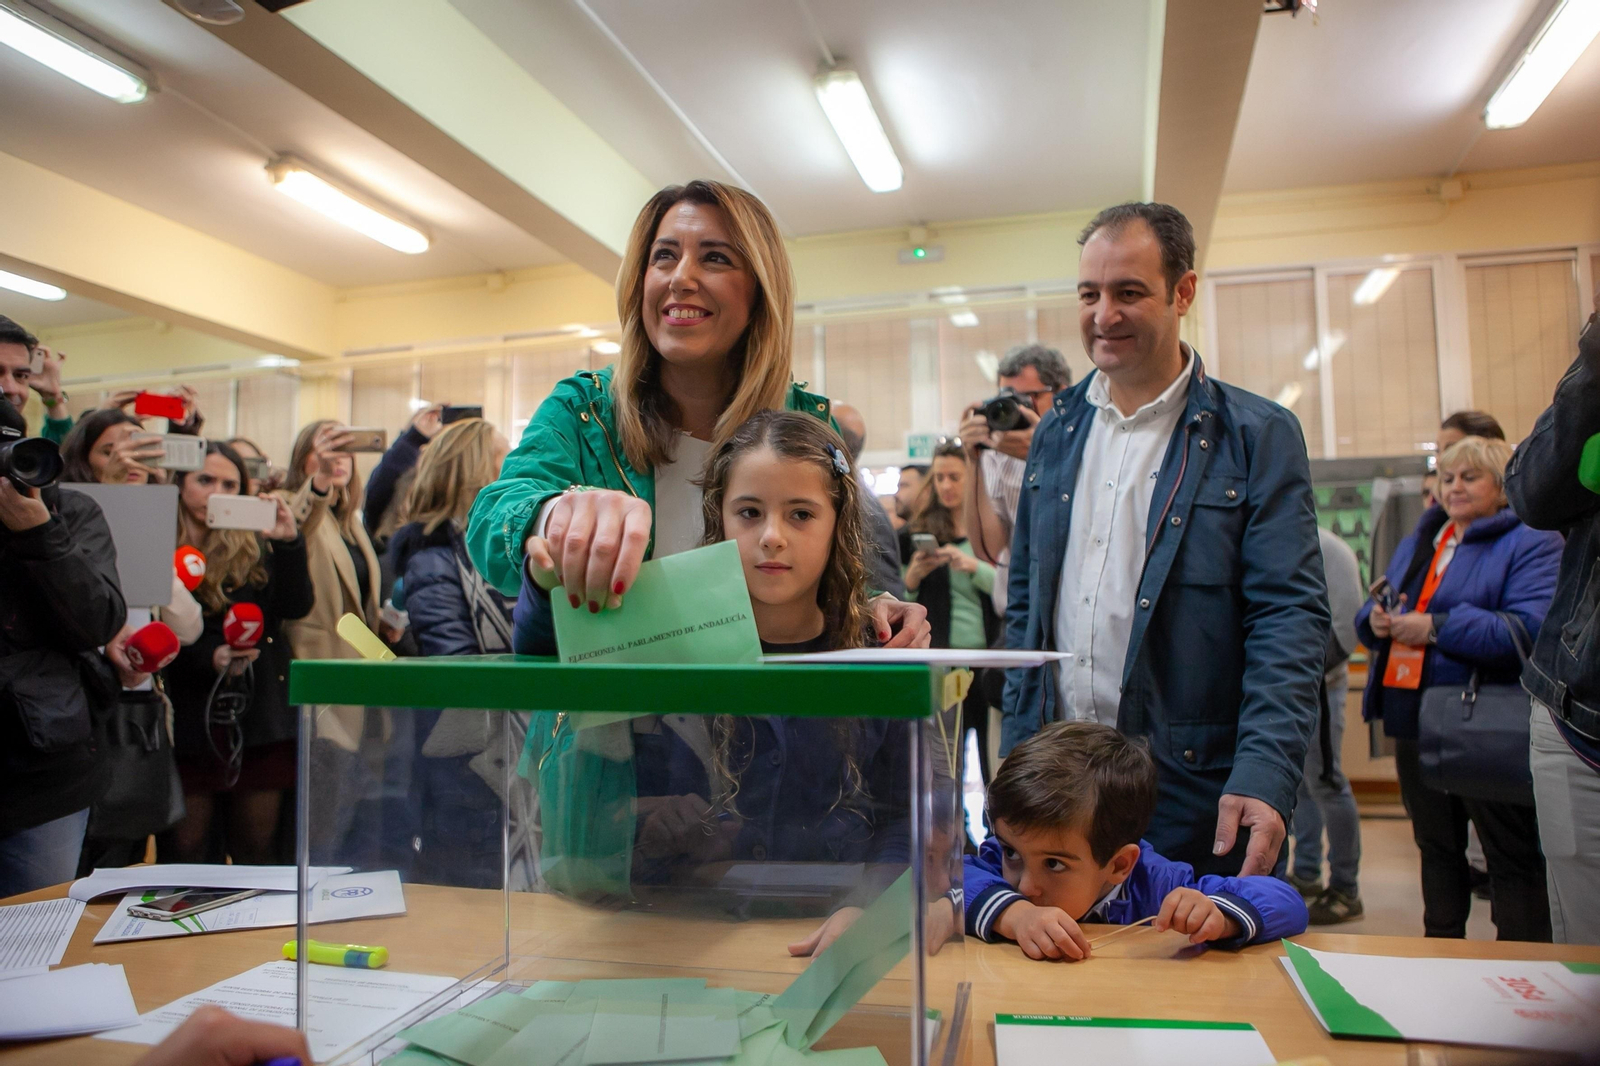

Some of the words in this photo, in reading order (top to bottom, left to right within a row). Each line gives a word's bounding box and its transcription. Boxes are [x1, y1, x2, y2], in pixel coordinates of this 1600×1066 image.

[241, 621, 260, 642] 7
[568, 646, 616, 663] ELECCIONES
[617, 643, 627, 651] AL
[628, 628, 683, 649] PARLAMENTO
[684, 625, 697, 635] DE
[698, 613, 747, 632] ANDALUCÍA
